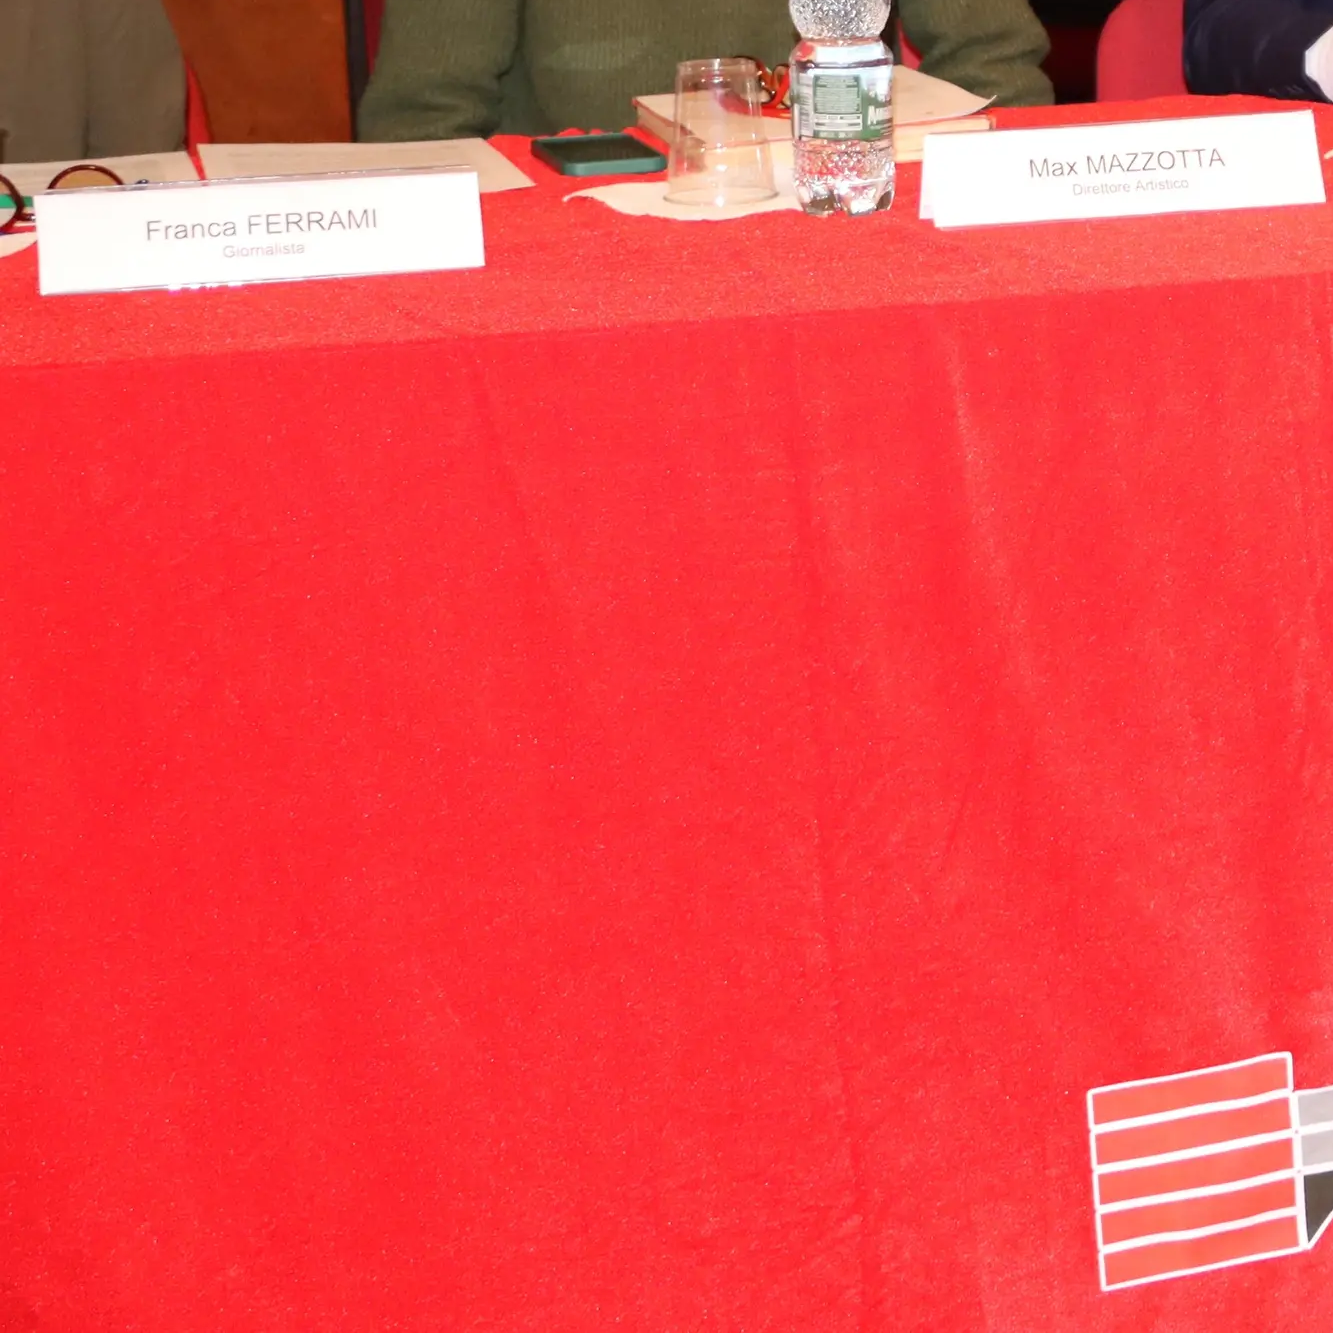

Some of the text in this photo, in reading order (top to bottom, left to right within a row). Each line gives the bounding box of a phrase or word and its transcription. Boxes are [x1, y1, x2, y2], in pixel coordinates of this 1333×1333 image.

[1029, 147, 1226, 179] Max MAZZOTTA
[1072, 177, 1189, 197] Direttore Artistico
[146, 208, 378, 242] Franca FERRAMI
[222, 242, 305, 259] Giornalista
